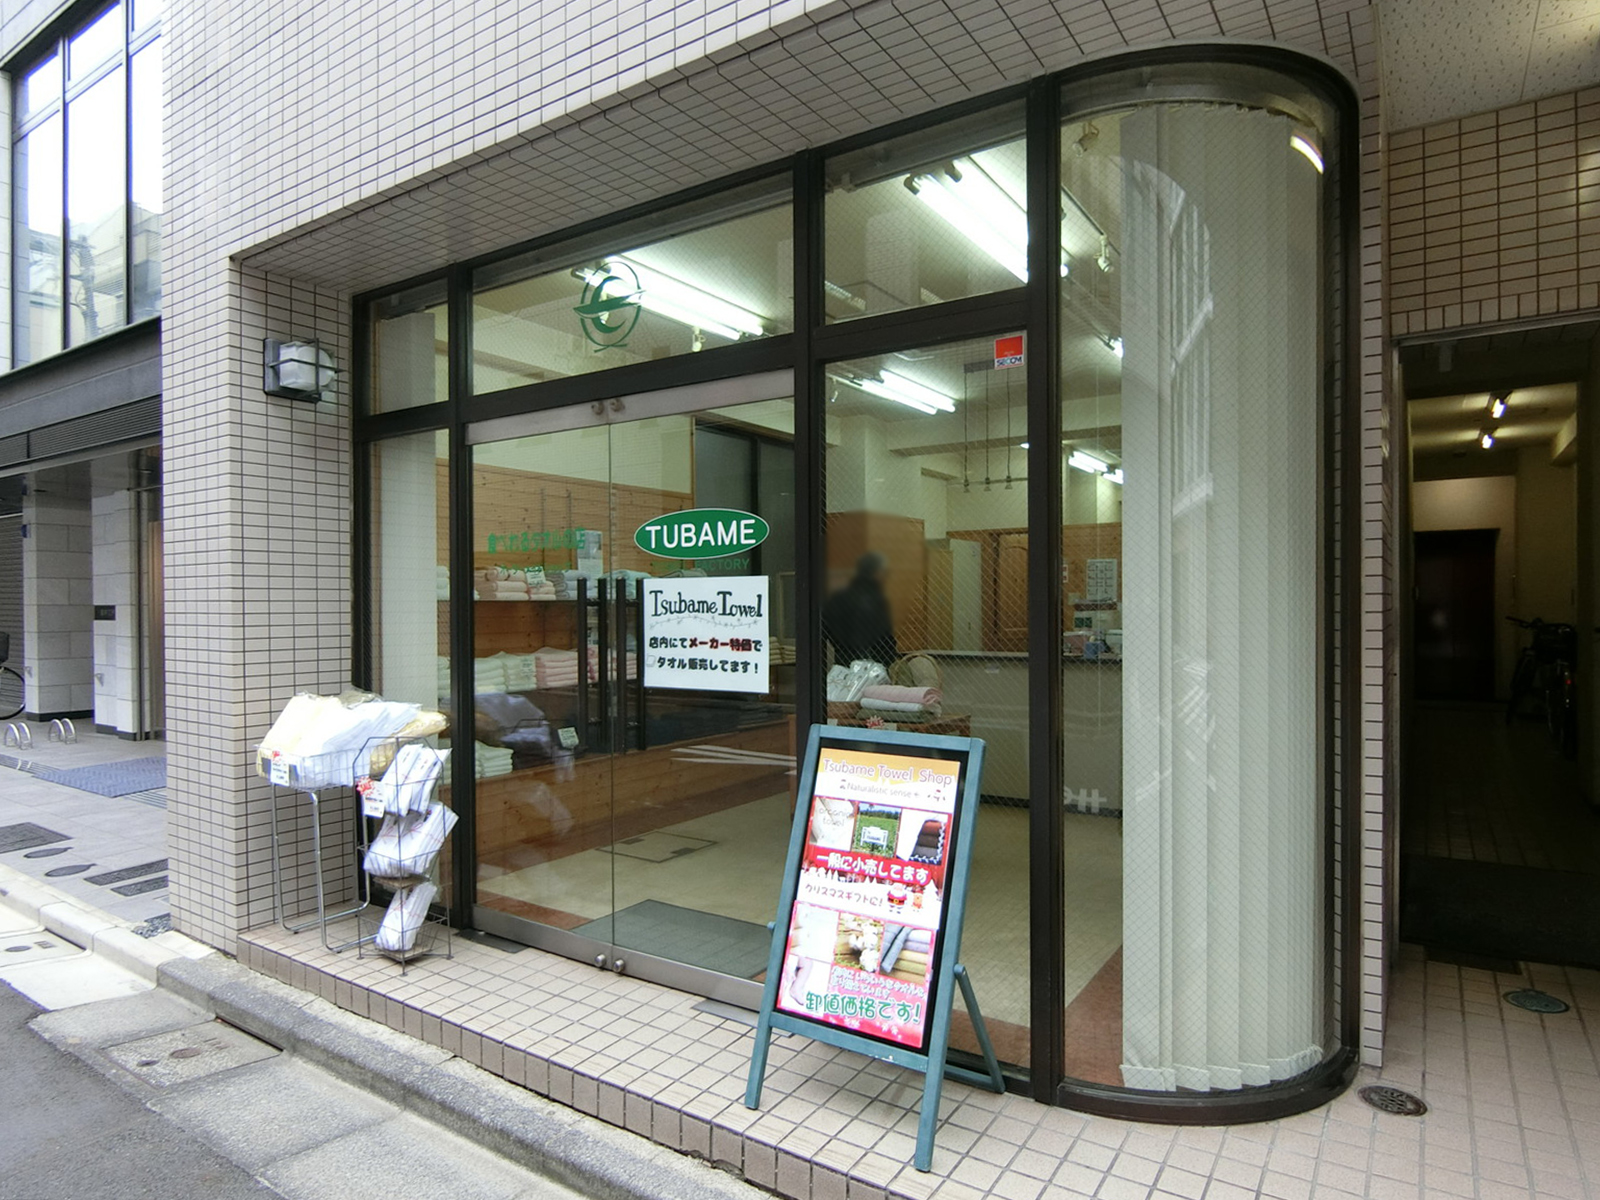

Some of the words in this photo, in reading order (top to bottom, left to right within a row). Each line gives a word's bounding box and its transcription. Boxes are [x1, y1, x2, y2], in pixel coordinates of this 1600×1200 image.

[645, 519, 756, 549] TUBAME
[649, 590, 718, 617] Tsubame
[717, 591, 763, 618] Towel
[649, 636, 763, 652] 店内にてメーカー特価で
[823, 759, 875, 777] Tsubame
[878, 765, 914, 781] Towel
[919, 769, 953, 788] Shop
[847, 782, 888, 796] Naturalistic
[890, 788, 912, 799] sense
[816, 852, 929, 884] 一般に小売してます
